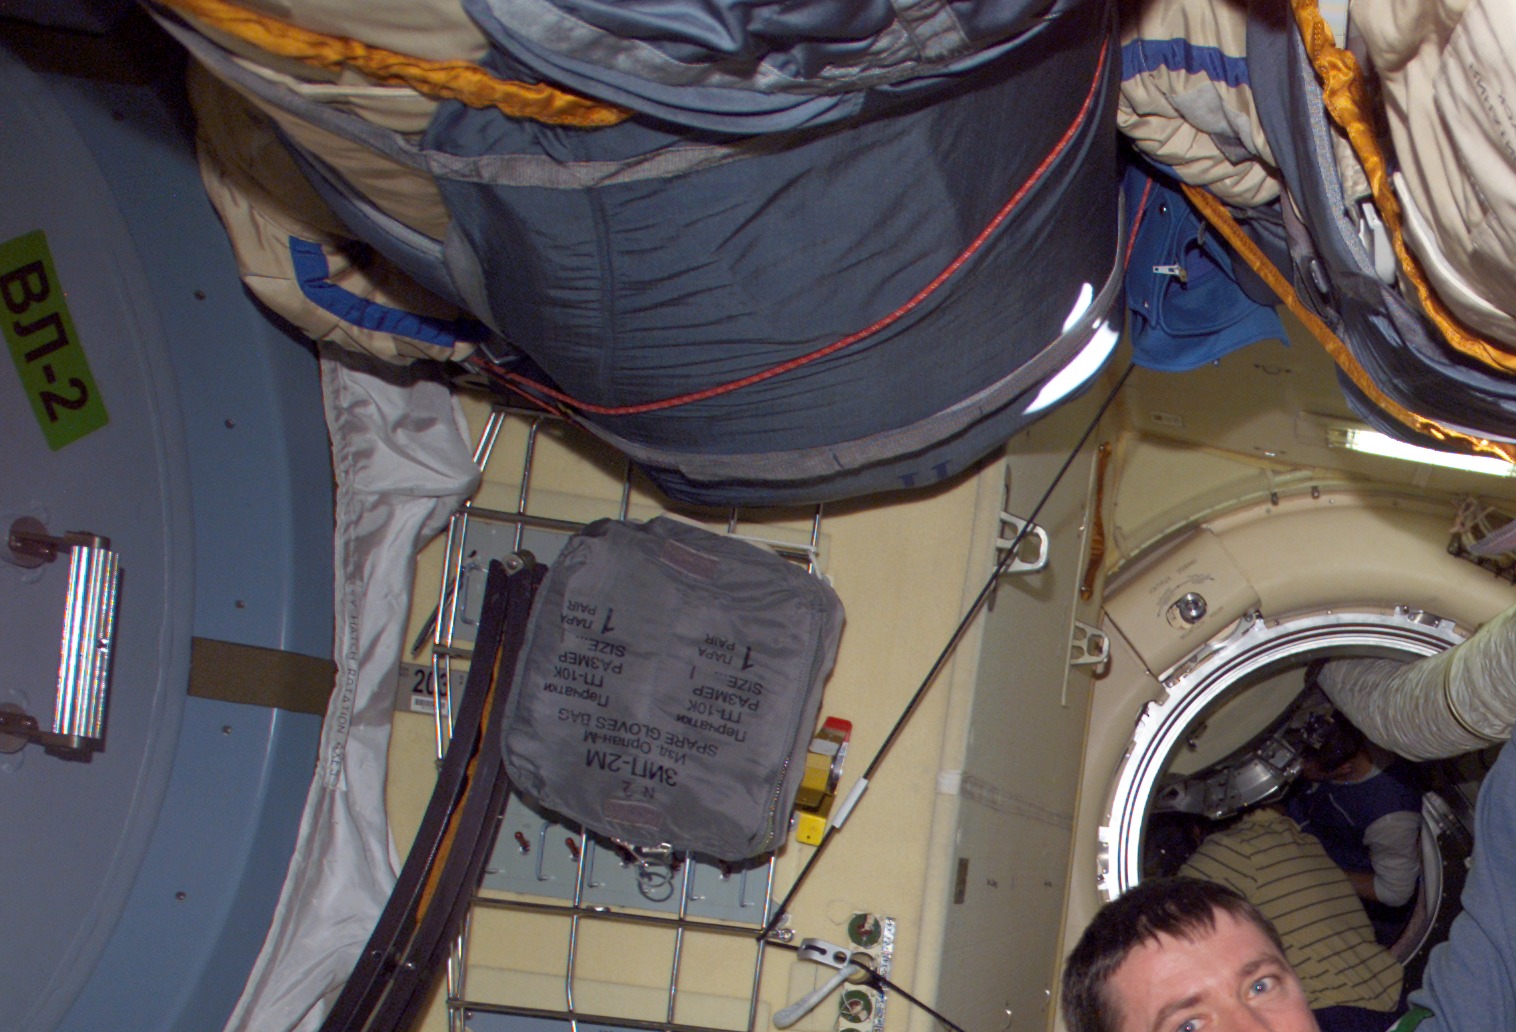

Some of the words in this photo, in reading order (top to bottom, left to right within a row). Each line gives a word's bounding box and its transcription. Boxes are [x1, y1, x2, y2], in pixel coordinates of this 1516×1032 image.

[0, 259, 89, 423] ВЛ-2
[560, 613, 594, 630] ПАРА
[567, 600, 598, 617] PAIR
[601, 607, 615, 634] 1
[349, 615, 359, 660] HATCH
[704, 632, 737, 652] PAIR
[558, 651, 624, 675] РАЗМЕР
[698, 646, 733, 666] ПАРА
[741, 645, 755, 672] 1
[337, 667, 357, 735] ROTATION
[543, 682, 610, 708] Перчатки
[692, 685, 761, 712] РАЗМЕР
[557, 707, 592, 726] BAG
[595, 716, 662, 741] GLOVES
[676, 713, 748, 743] Перчатки
[582, 730, 651, 755] Орлан-М
[664, 731, 719, 757] SPARE
[585, 748, 679, 787] ЗИП-2М
